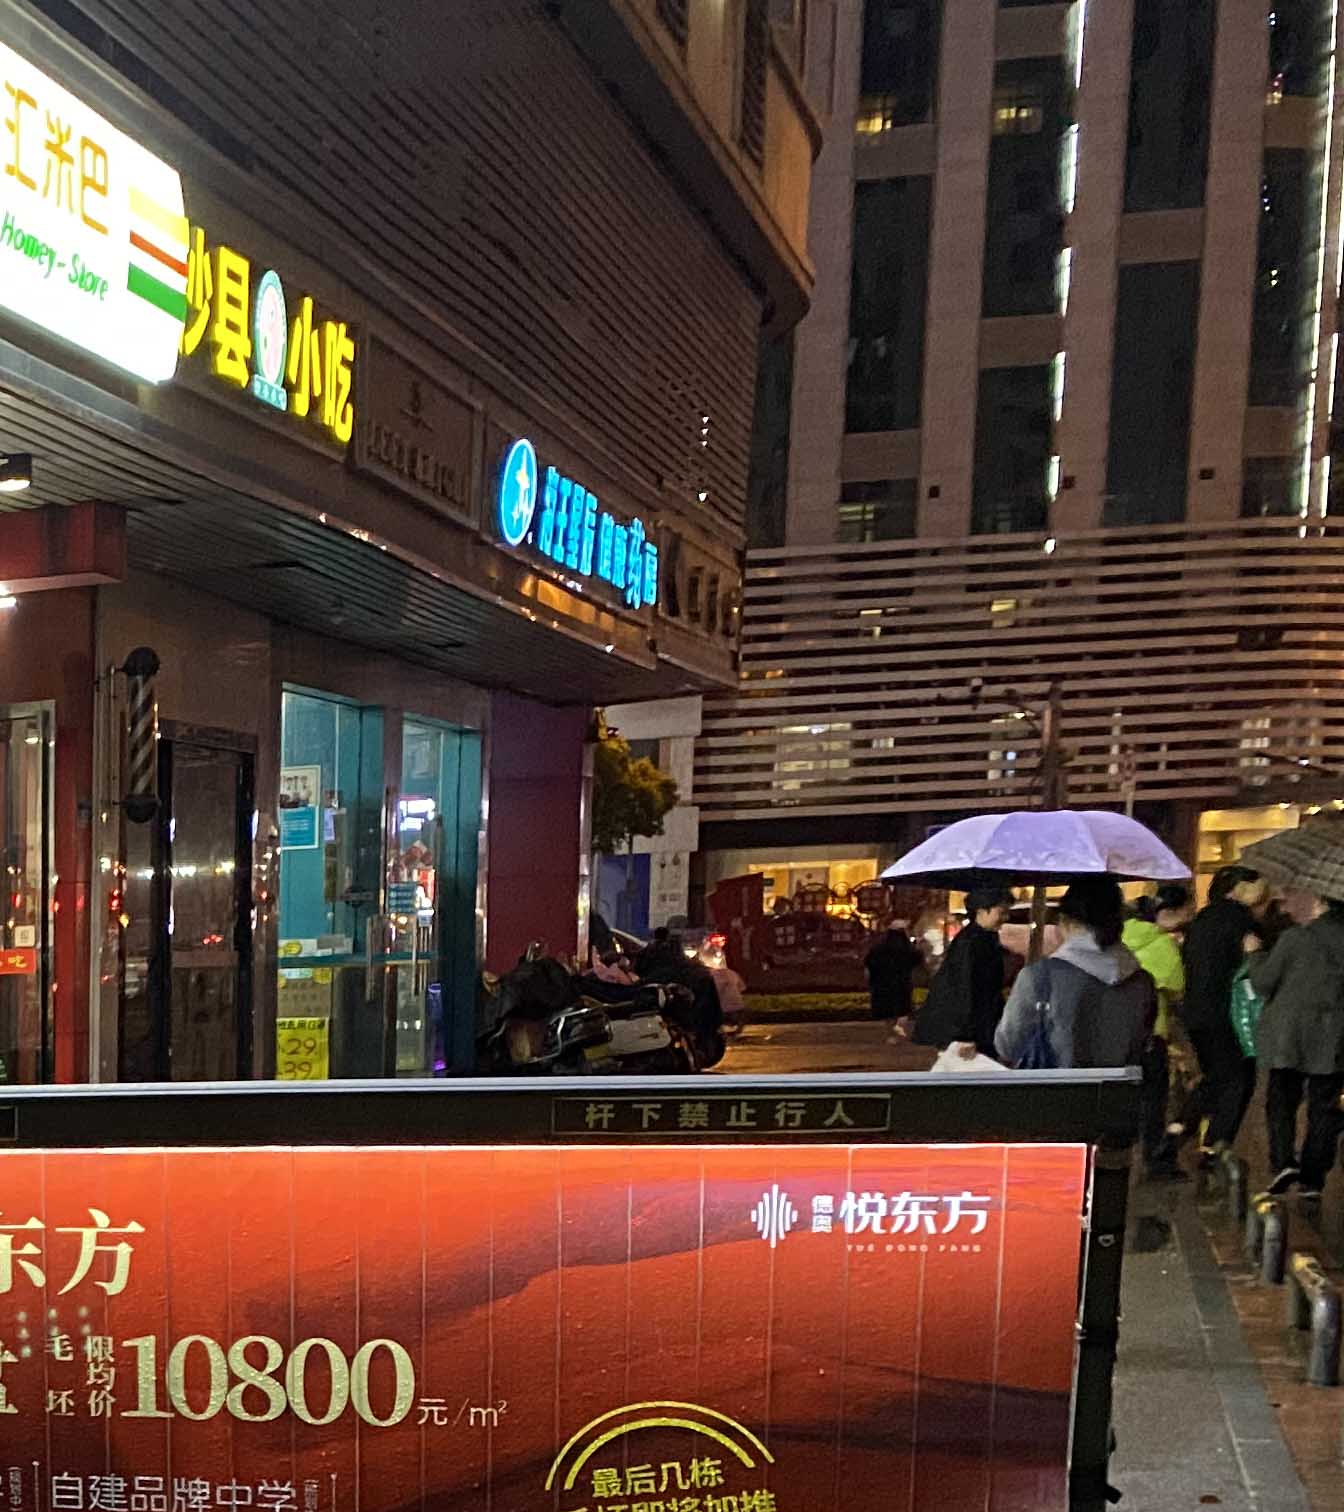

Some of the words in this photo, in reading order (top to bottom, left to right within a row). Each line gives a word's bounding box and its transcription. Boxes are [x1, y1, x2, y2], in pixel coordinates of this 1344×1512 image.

[4, 79, 109, 237] 汇米巴
[584, 1101, 855, 1129] 杆下禁止行人
[839, 1191, 992, 1235] 悦东方
[119, 1335, 416, 1427] 10800
[591, 1457, 726, 1498] 最后几栋
